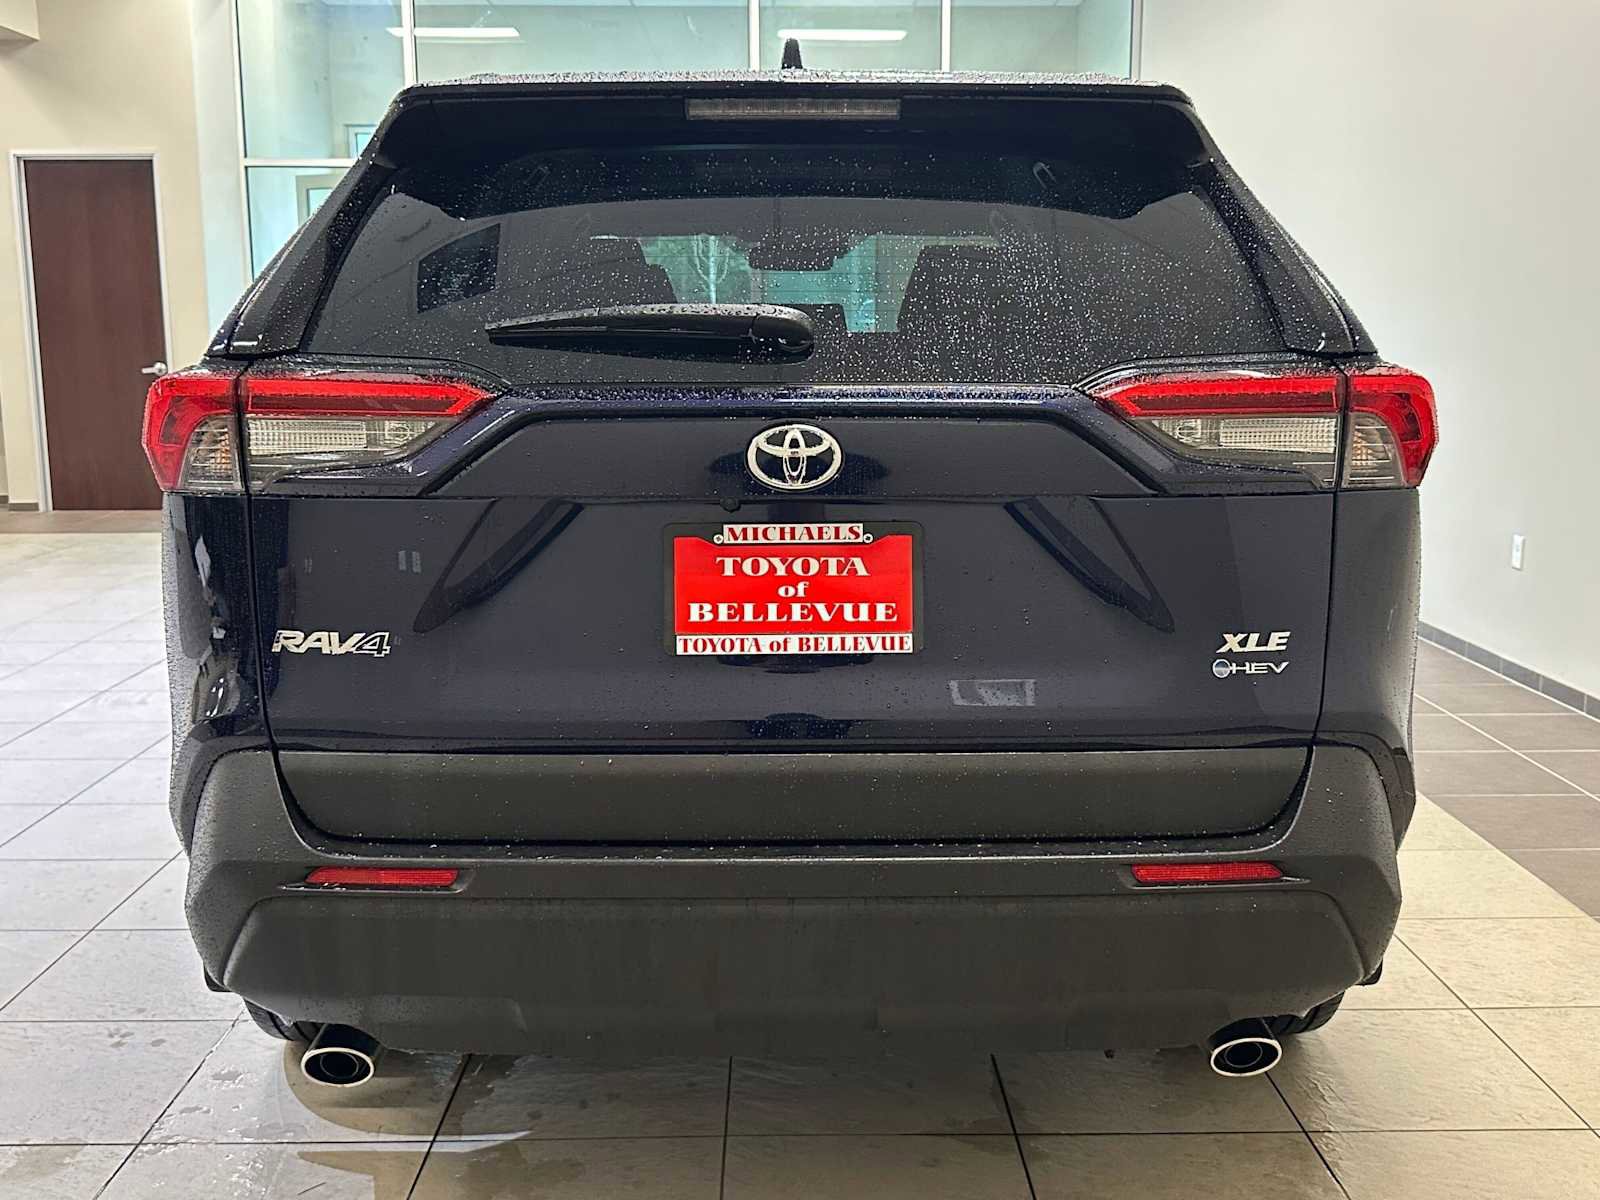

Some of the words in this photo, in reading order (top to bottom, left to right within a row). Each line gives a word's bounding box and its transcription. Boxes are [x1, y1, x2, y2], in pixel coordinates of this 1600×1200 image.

[726, 525, 863, 542] MICHAELS
[715, 556, 871, 577] TOYOTA
[777, 581, 810, 598] of
[687, 602, 899, 623] BELLEVUE
[271, 629, 392, 657] RAV4
[677, 636, 763, 654] TOYOTA
[768, 636, 792, 653] of
[799, 635, 911, 652] BELLEVUE
[1215, 631, 1292, 654] XLE
